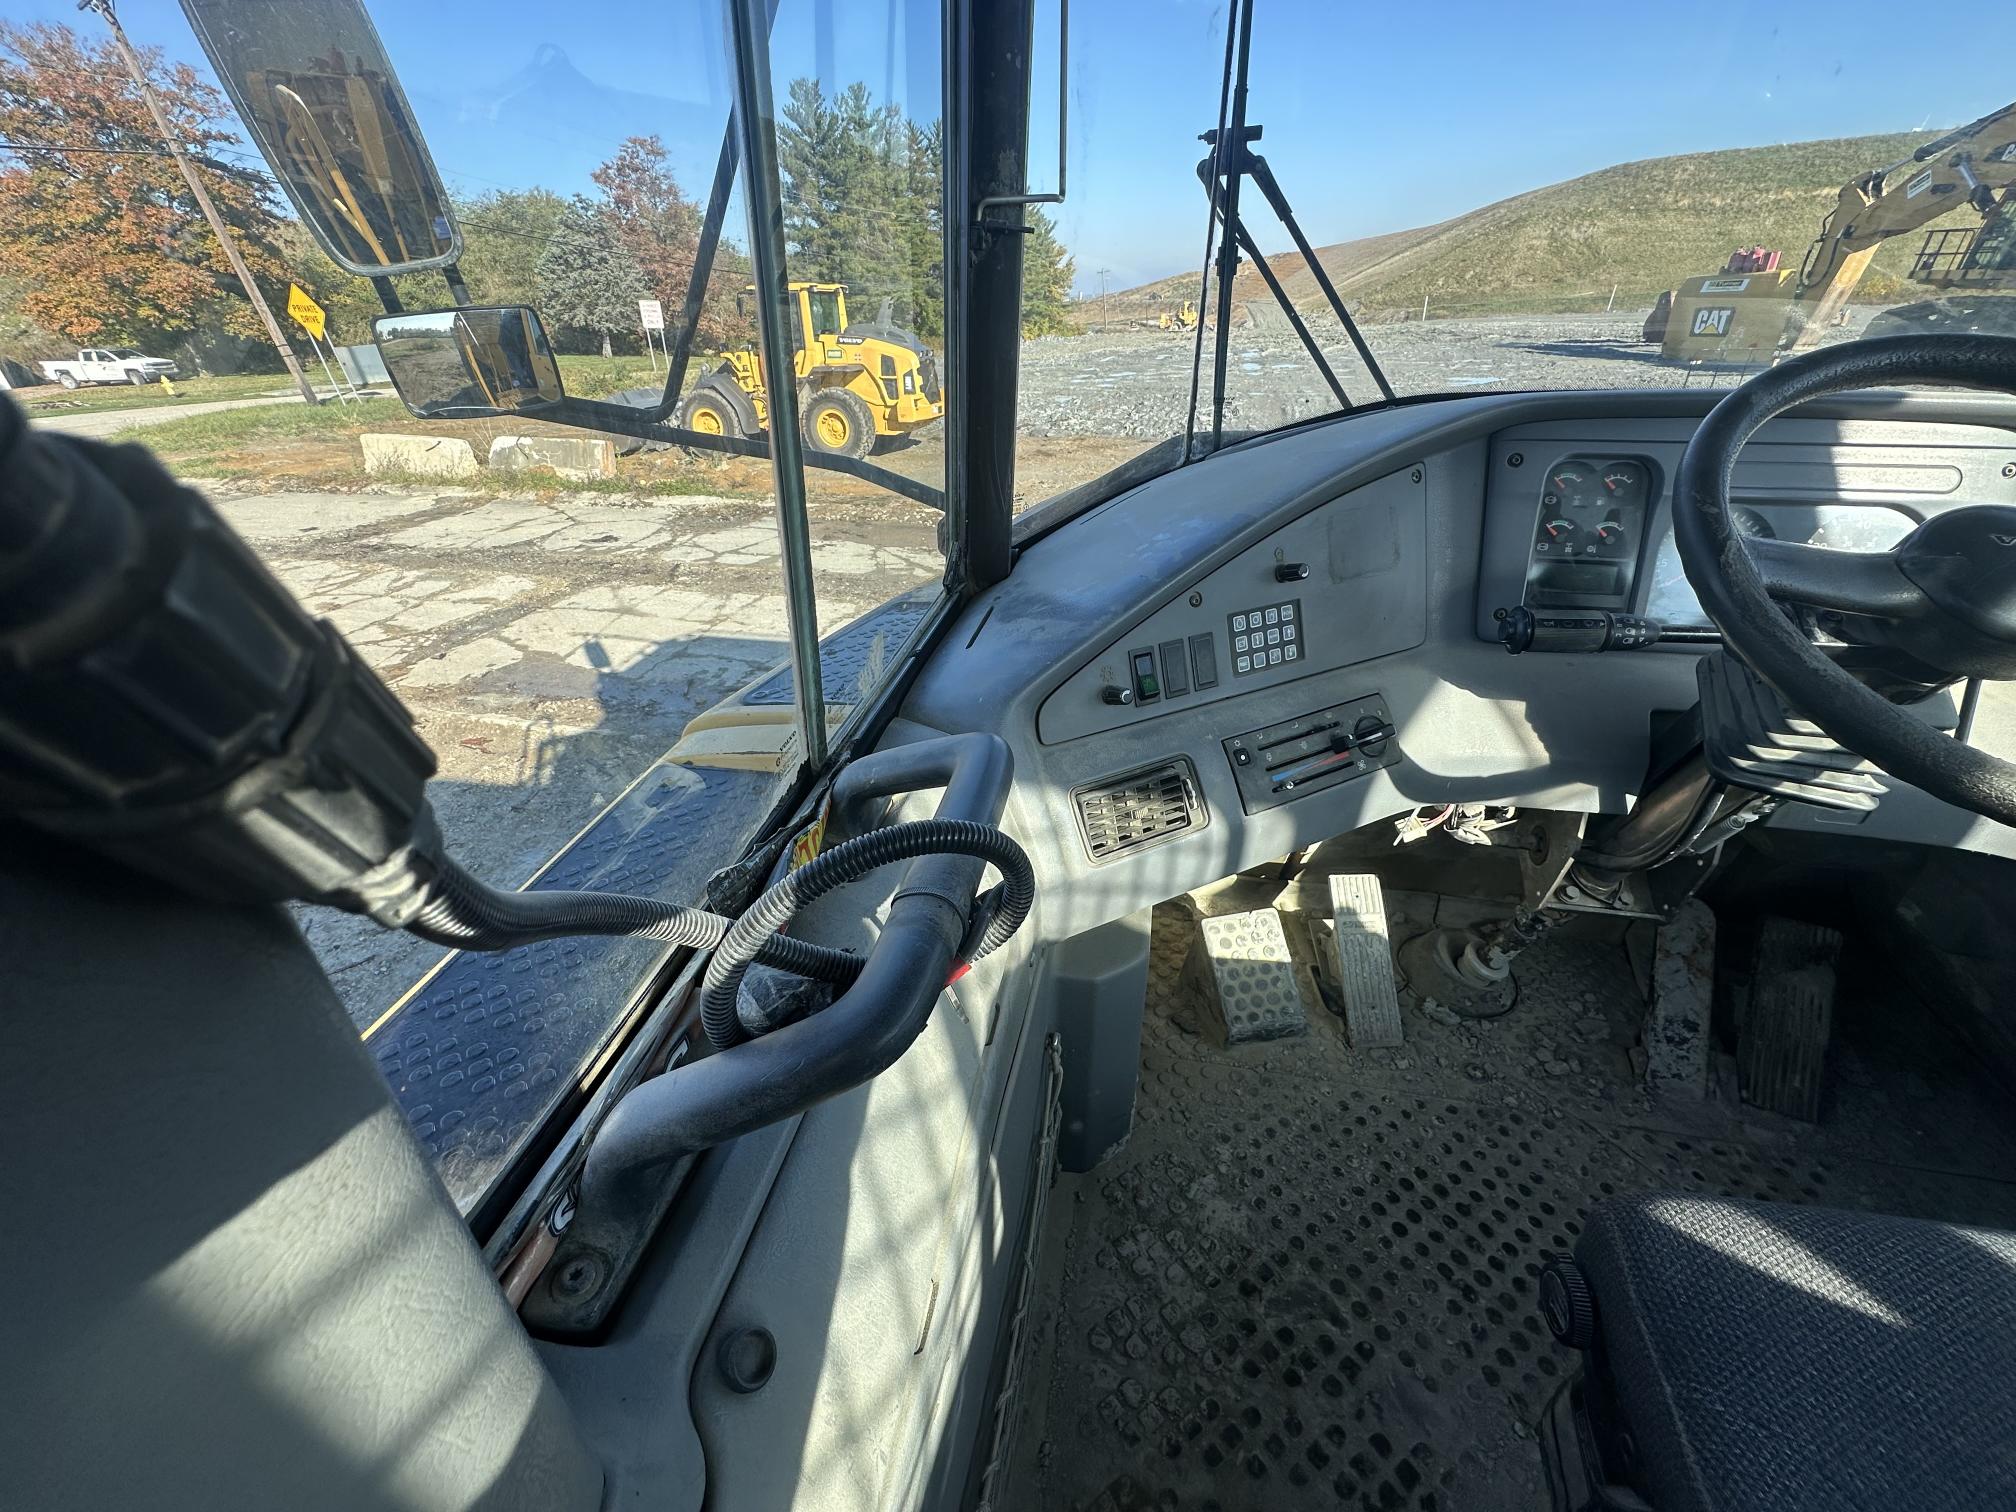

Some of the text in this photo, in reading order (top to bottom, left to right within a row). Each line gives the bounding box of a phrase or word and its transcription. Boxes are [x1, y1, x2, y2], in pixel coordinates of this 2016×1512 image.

[291, 304, 318, 314] PRIVATE
[300, 314, 321, 324] DRIVE
[1693, 310, 1732, 334] CAT
[779, 730, 797, 752] VOLVO
